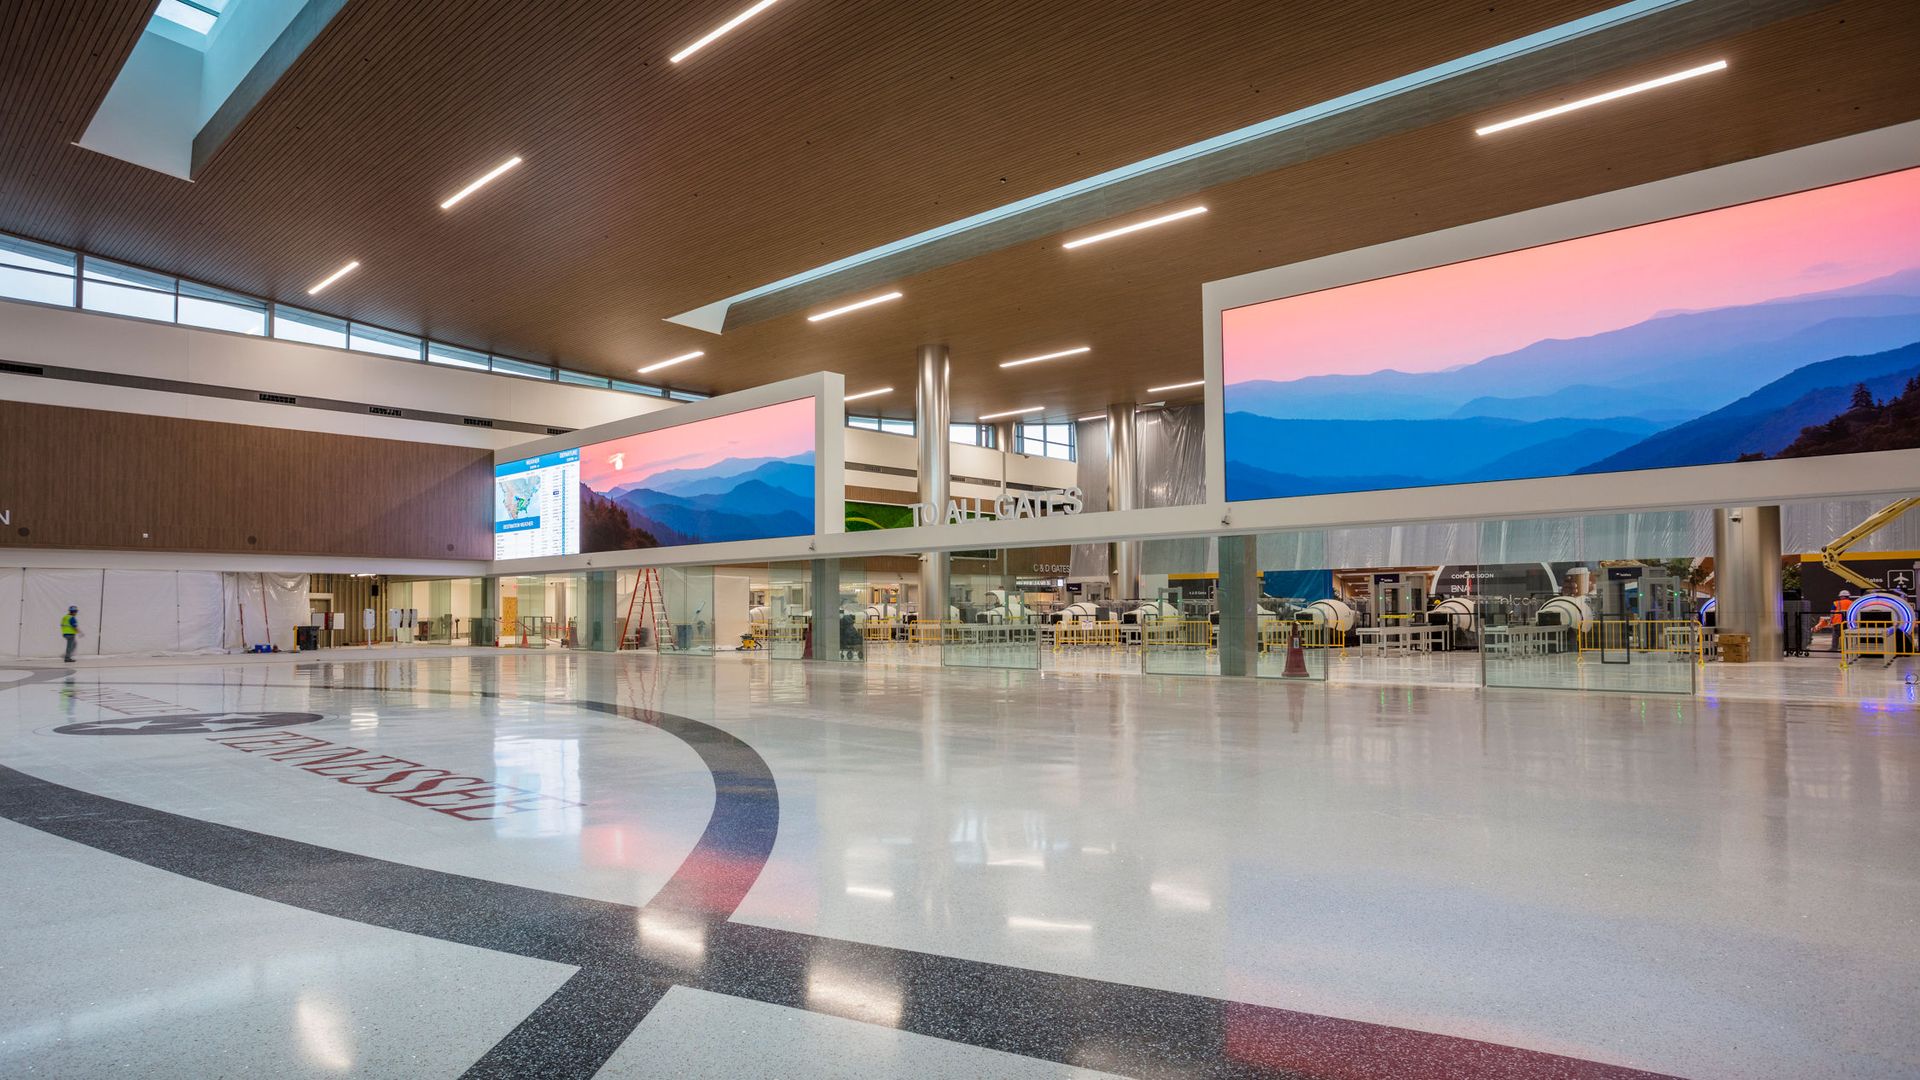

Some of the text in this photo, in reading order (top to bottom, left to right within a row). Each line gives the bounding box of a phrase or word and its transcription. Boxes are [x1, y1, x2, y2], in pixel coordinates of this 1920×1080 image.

[908, 487, 1083, 528] TO ALL GATES
[1033, 564, 1071, 573] C & D GATES
[205, 731, 588, 821] TENNESSEE
